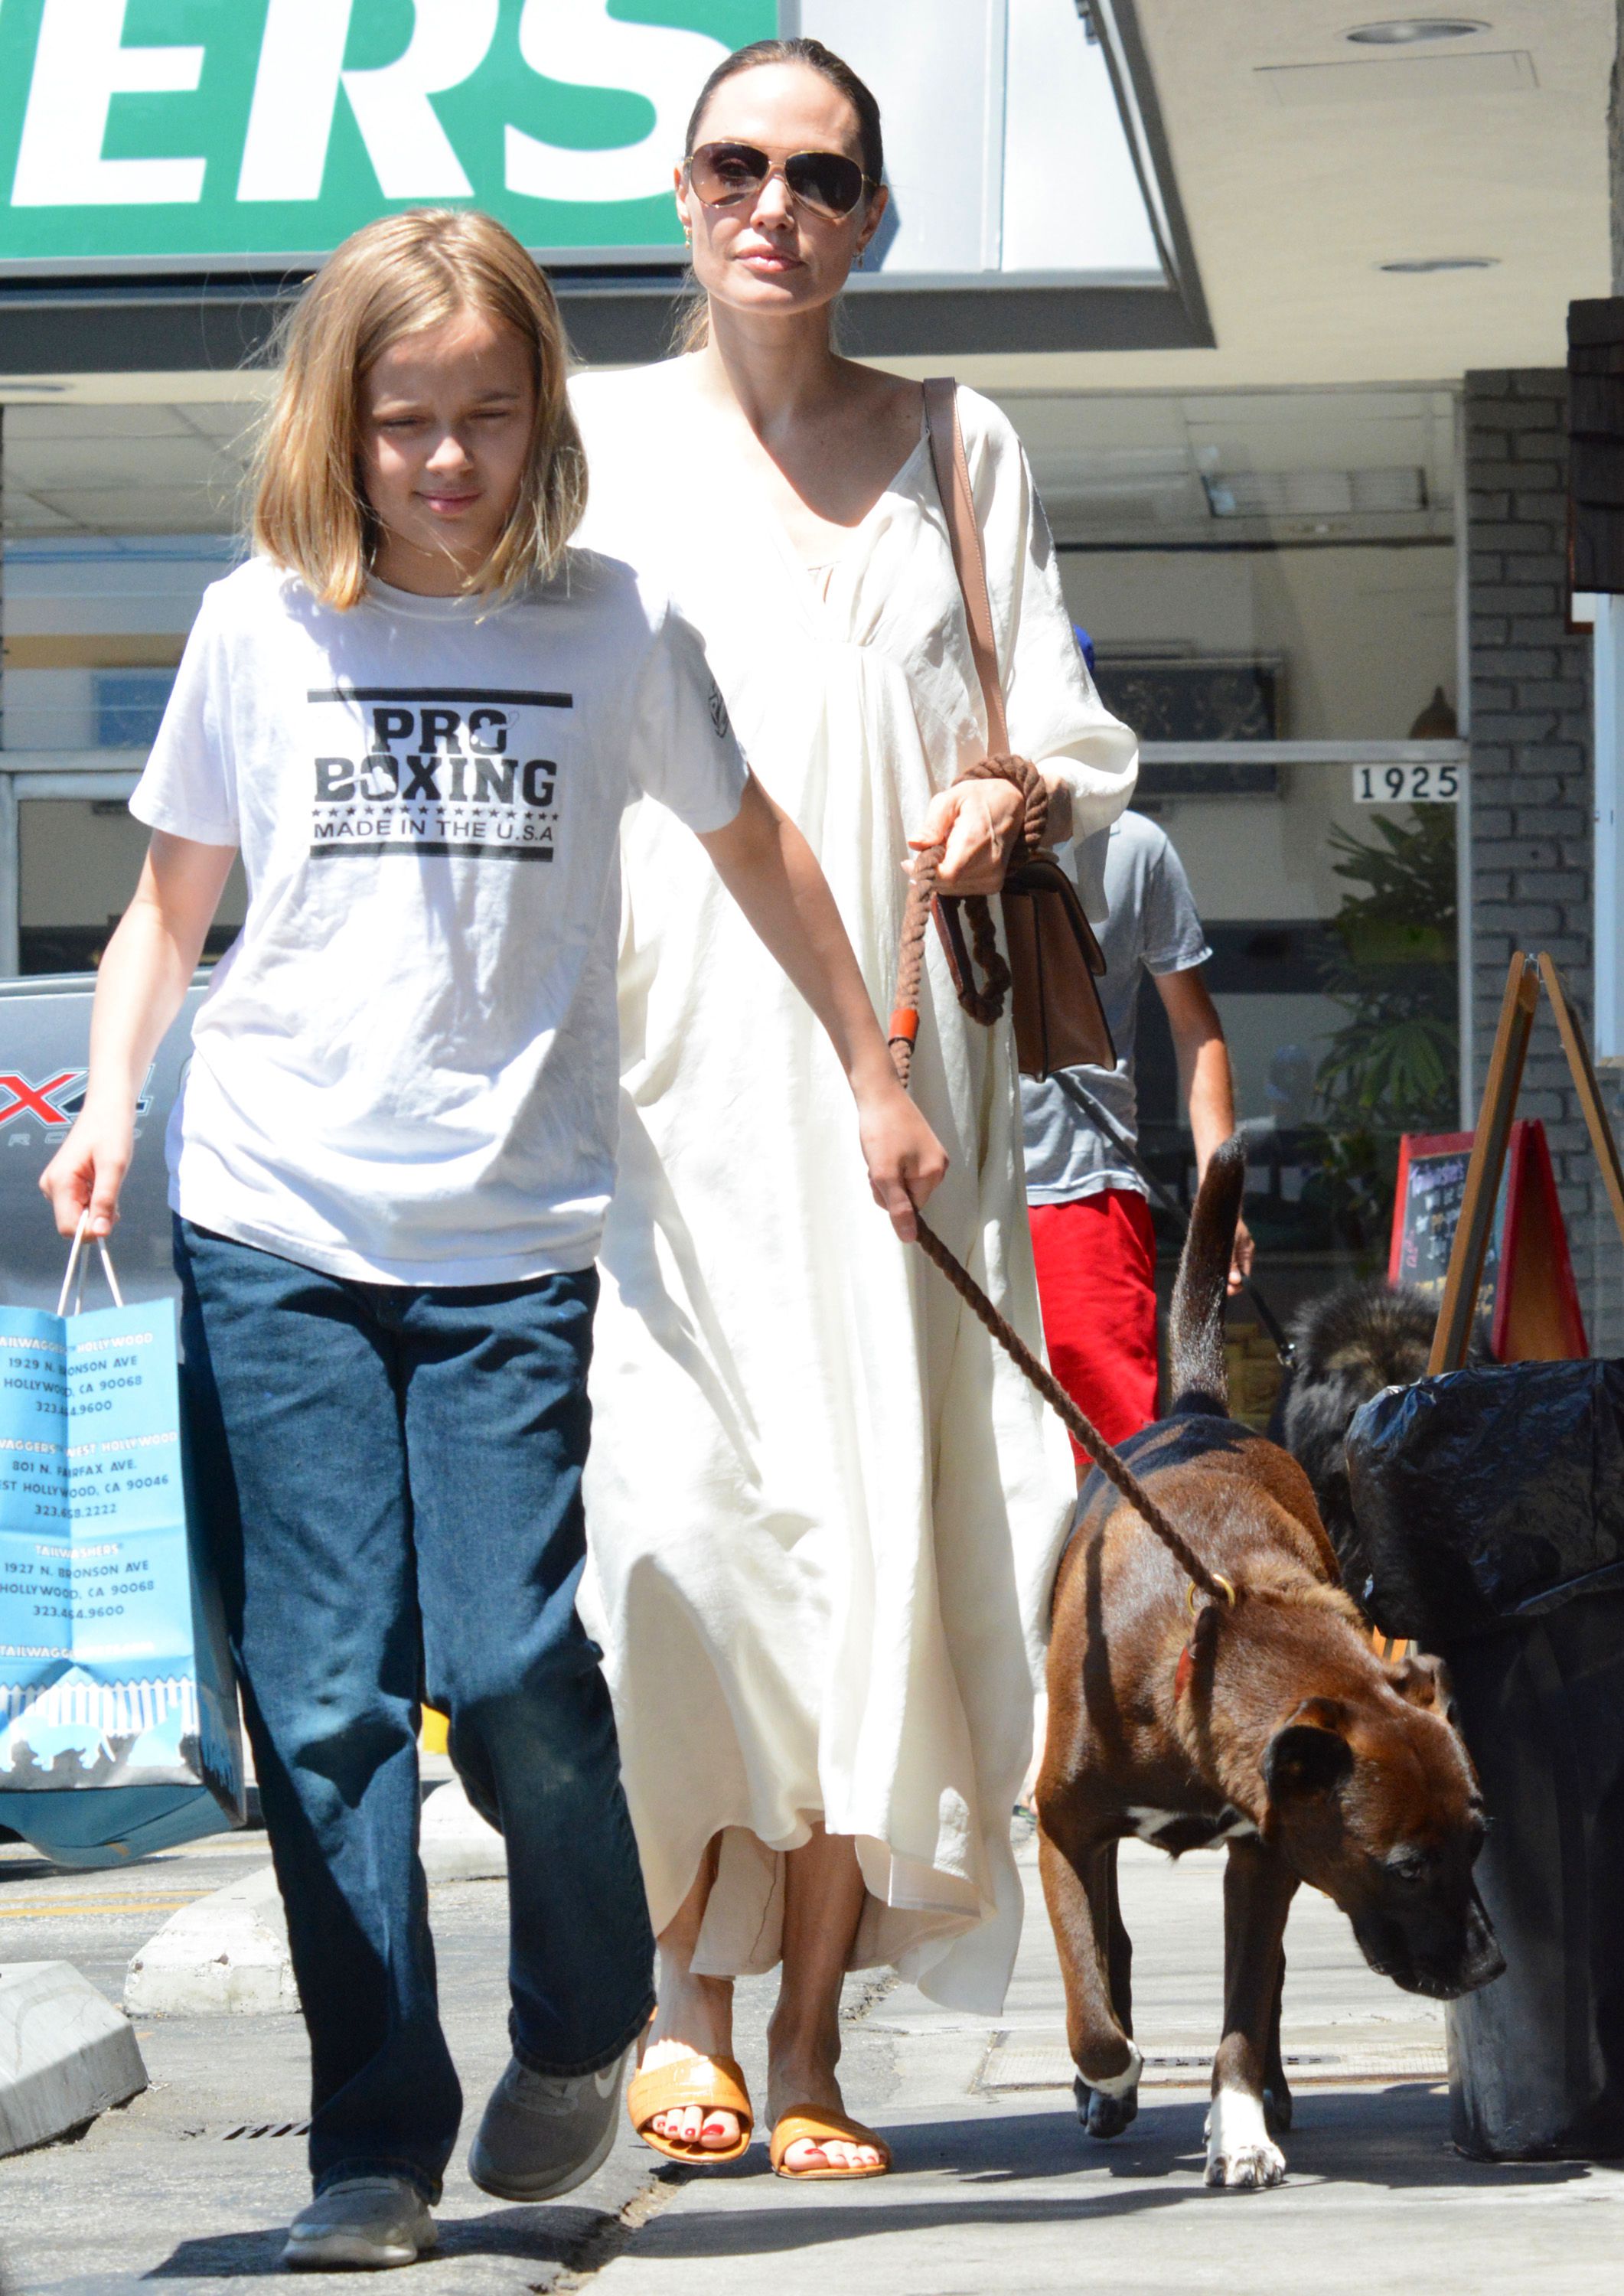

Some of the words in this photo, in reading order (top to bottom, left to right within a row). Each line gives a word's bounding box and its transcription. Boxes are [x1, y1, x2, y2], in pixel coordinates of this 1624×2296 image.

[371, 708, 508, 755] PRO
[314, 754, 558, 807] BOXING
[1361, 766, 1458, 799] 1925
[313, 820, 391, 839] MADE
[401, 820, 426, 836] IN
[435, 820, 488, 838] THE
[77, 1332, 153, 1353] HOLLYWOOD
[8, 1358, 39, 1370] 1929
[44, 1362, 55, 1373] N.
[113, 1355, 138, 1368] AVE
[79, 1383, 93, 1394] CA
[100, 1375, 142, 1391] 90068
[102, 1431, 178, 1453] HOLLYWOOD
[12, 1460, 34, 1472] 801
[40, 1463, 52, 1474] N.
[57, 1464, 103, 1479] FAIRFAX
[110, 1459, 137, 1473] AVE.
[105, 1482, 120, 1494] CA
[126, 1474, 169, 1490] 90046
[35, 1543, 119, 1559] TAILWASHERS
[4, 1562, 34, 1574] 1927
[40, 1566, 53, 1577] N.
[58, 1564, 119, 1580] BRONSON
[125, 1561, 149, 1573] AVE
[0, 1583, 82, 1600] HOLLYWOOD,
[88, 1587, 104, 1598] CA
[112, 1580, 155, 1595] 90068
